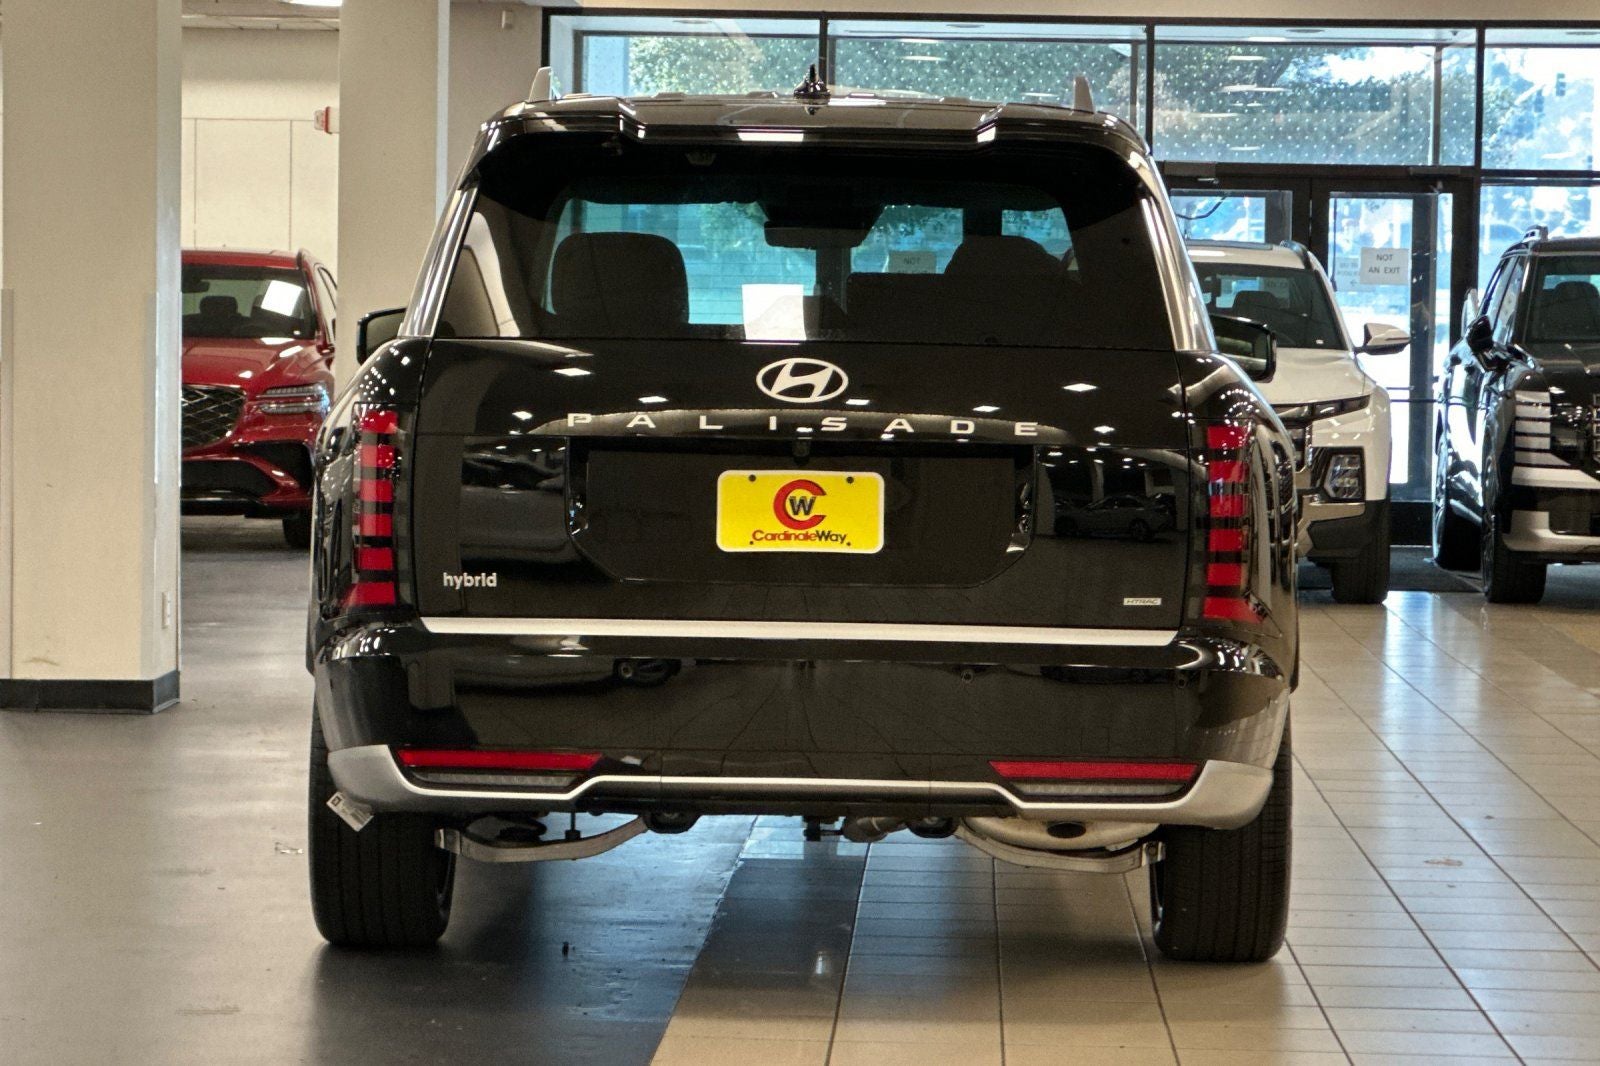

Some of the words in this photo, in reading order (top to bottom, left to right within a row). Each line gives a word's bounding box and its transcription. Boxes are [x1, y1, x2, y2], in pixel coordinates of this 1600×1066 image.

[1376, 253, 1394, 261] NOT
[1368, 266, 1380, 274] AN
[1384, 266, 1400, 274] EXIT
[567, 412, 1039, 437] PALISADE
[752, 529, 847, 544] CardinaleWay
[443, 572, 497, 590] hybrid
